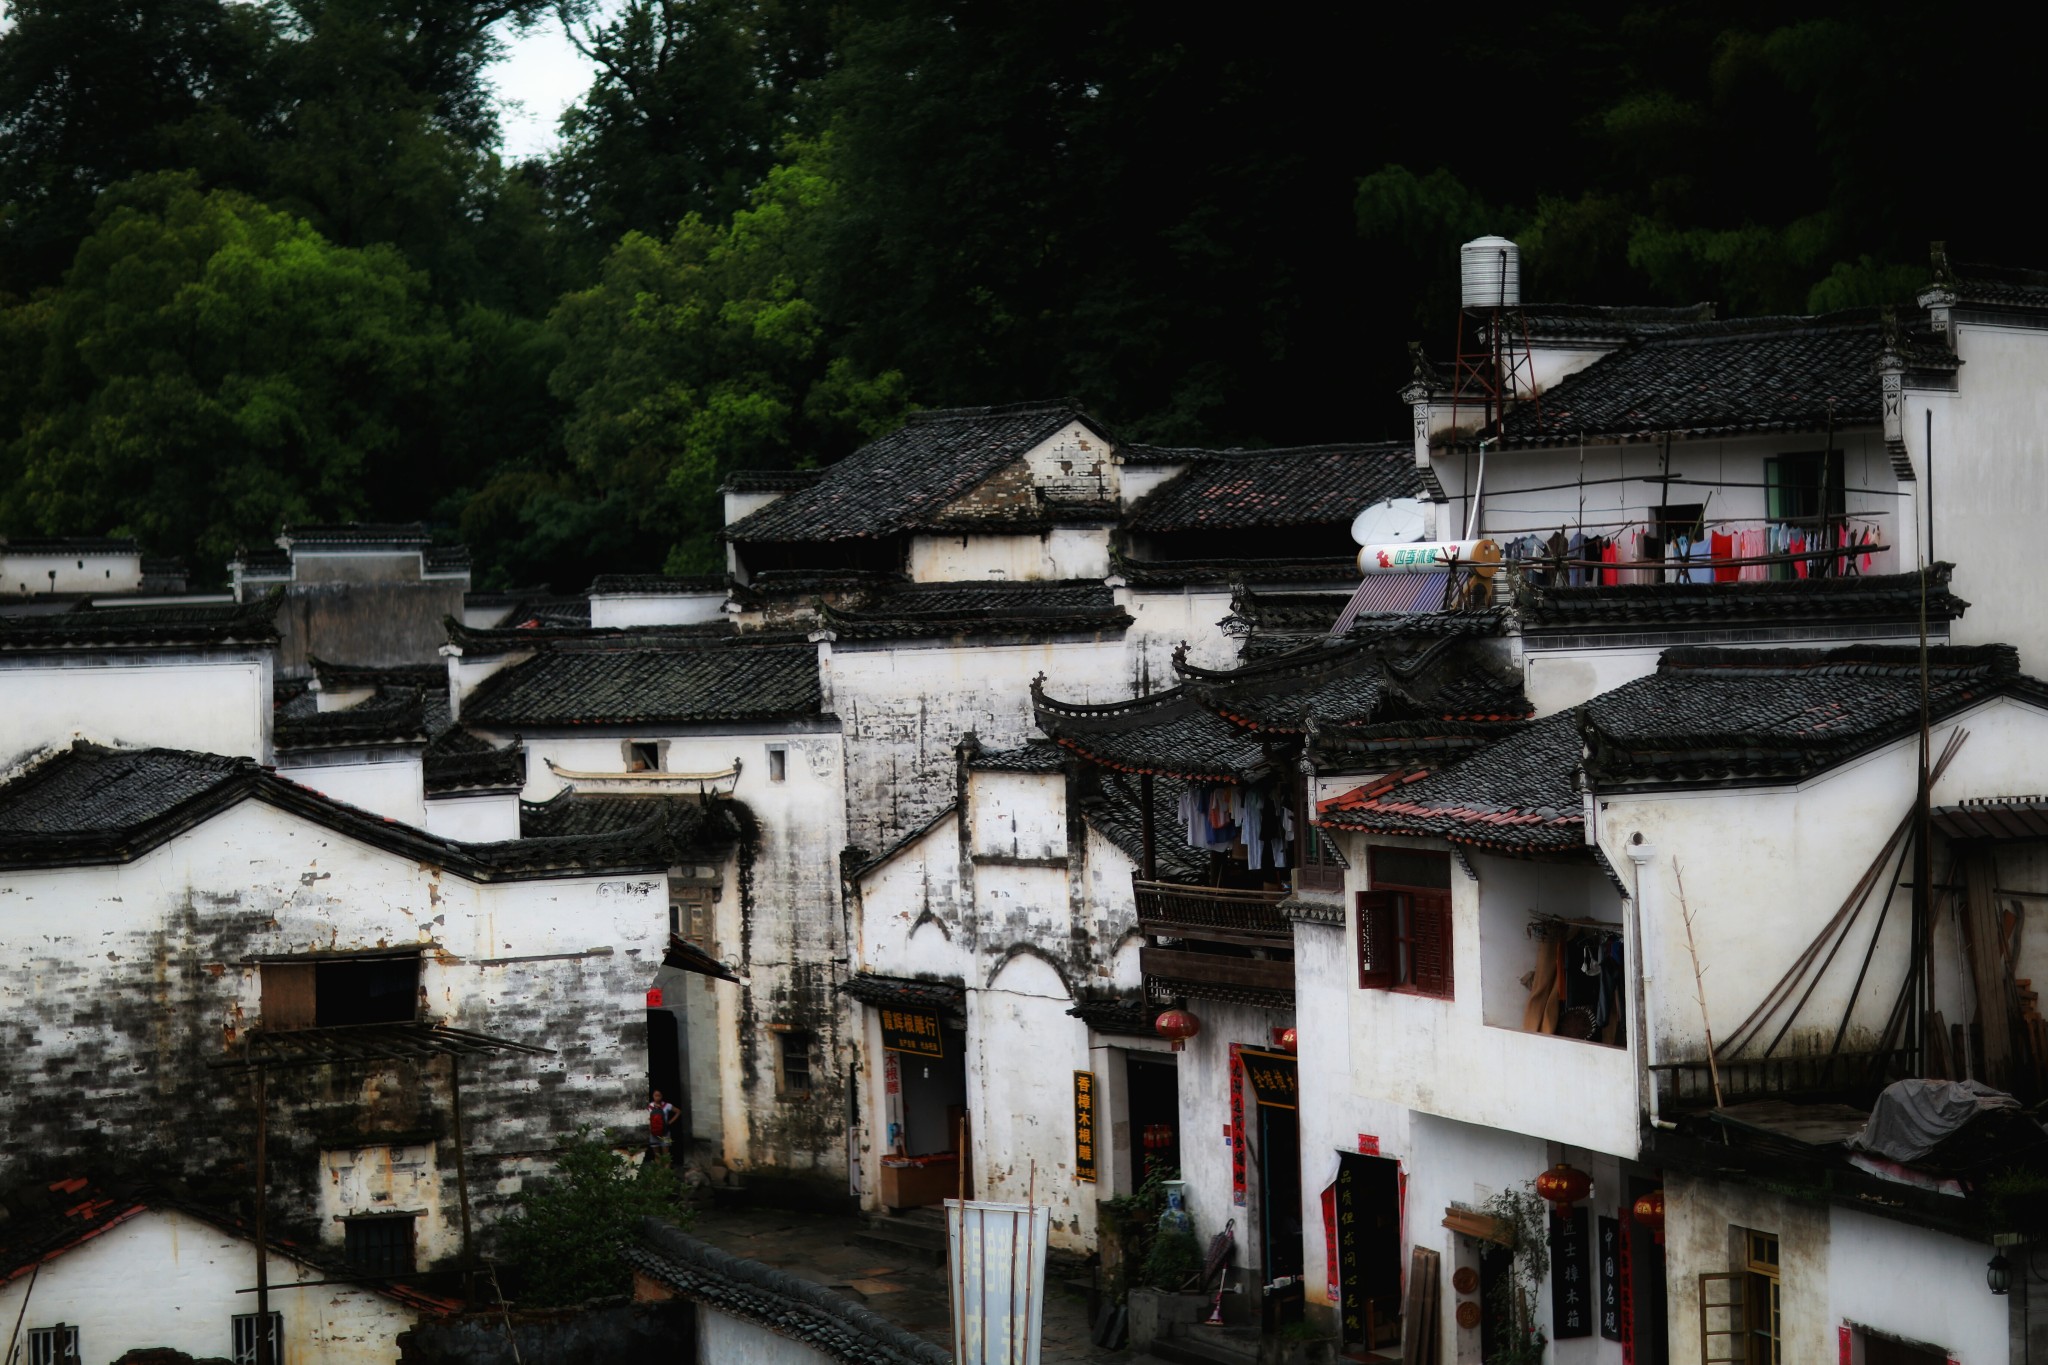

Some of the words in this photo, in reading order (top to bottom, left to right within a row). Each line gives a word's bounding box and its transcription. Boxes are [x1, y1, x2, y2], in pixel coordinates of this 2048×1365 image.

[1395, 548, 1438, 564] 四季沐歌
[1077, 1076, 1092, 1161] 香樟木根雕
